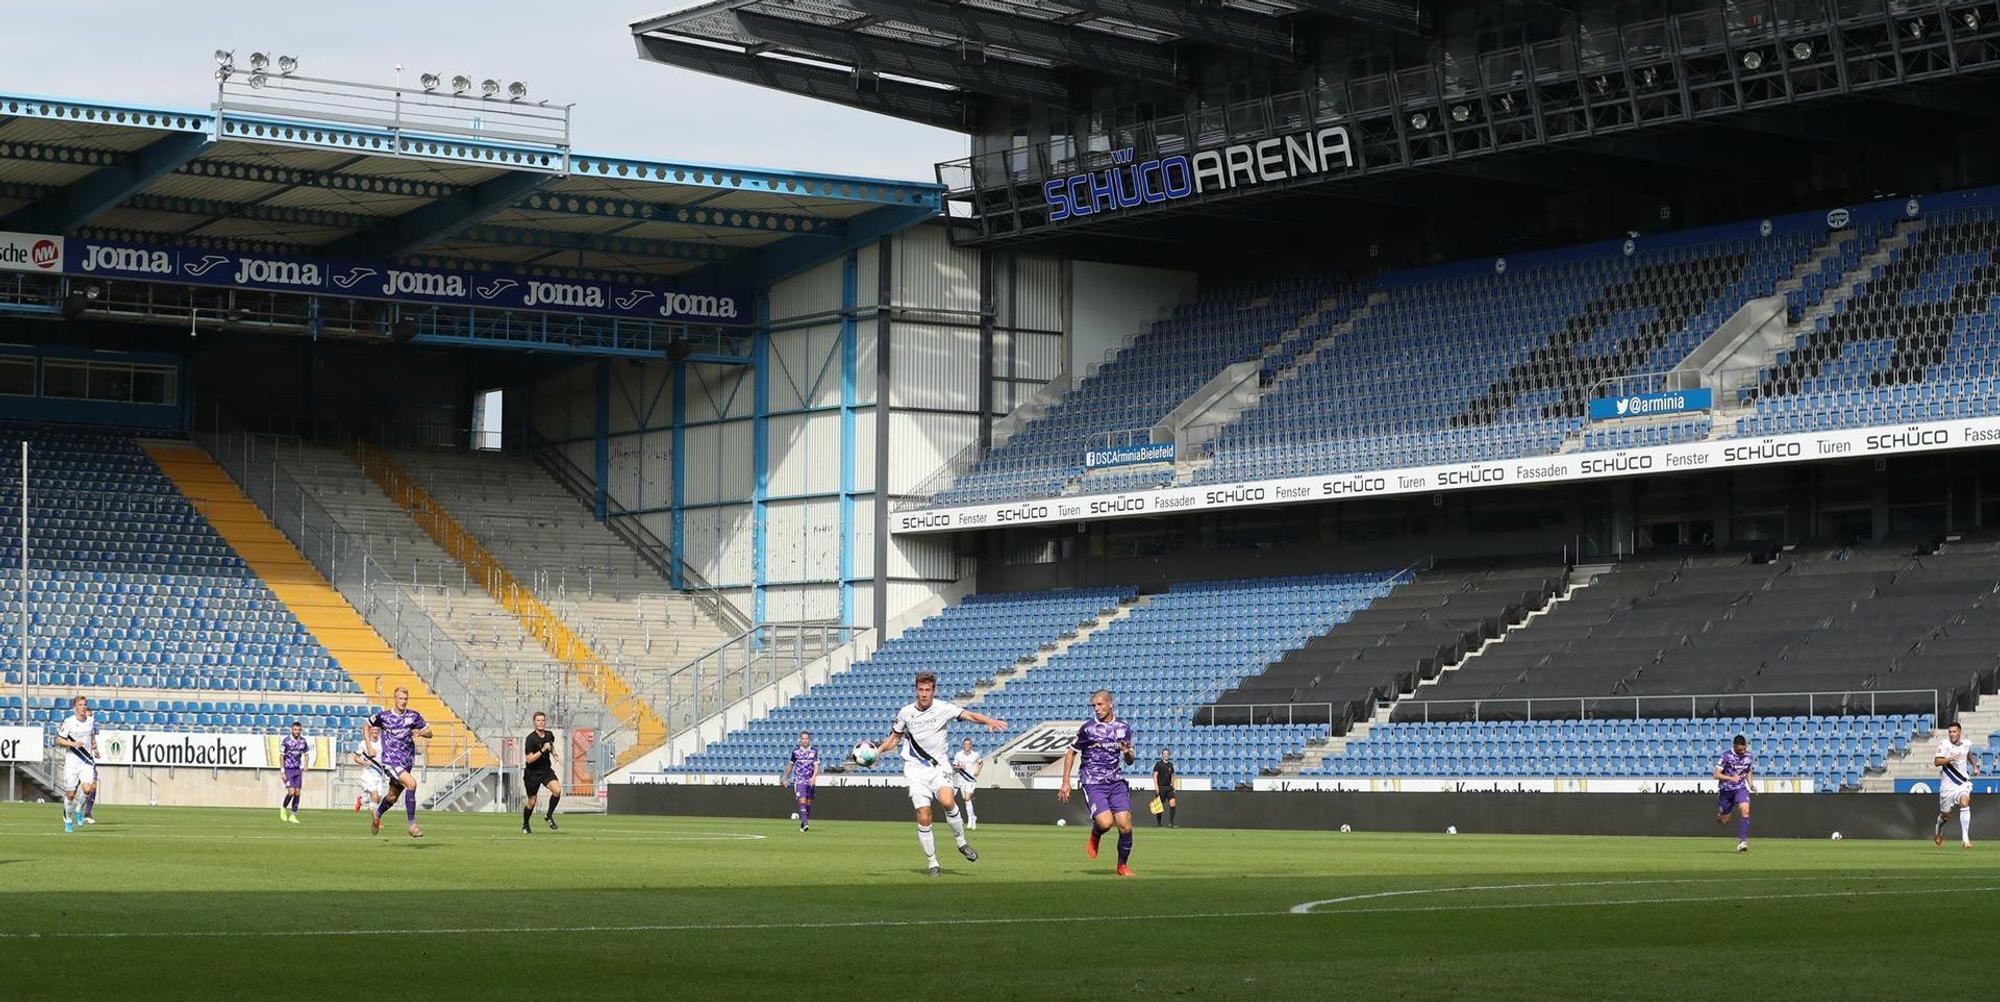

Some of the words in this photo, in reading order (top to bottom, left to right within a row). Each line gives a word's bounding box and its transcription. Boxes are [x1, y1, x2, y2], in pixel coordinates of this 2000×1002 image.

[82, 245, 172, 273] Joma
[234, 257, 322, 286] Joma
[383, 269, 466, 297] Joma
[524, 281, 604, 308] Joma
[660, 292, 737, 318] Joma
[1629, 393, 1685, 414] @arminia
[1096, 445, 1174, 466] DSCArminiaBielefeld
[958, 512, 988, 525] Fenster
[1154, 495, 1196, 509] Fassaden
[1275, 485, 1311, 499] Fenster
[1516, 464, 1568, 479] Fassaden
[1666, 453, 1709, 467] Fenster
[0, 738, 20, 759] er
[132, 734, 247, 766] Krombacher
